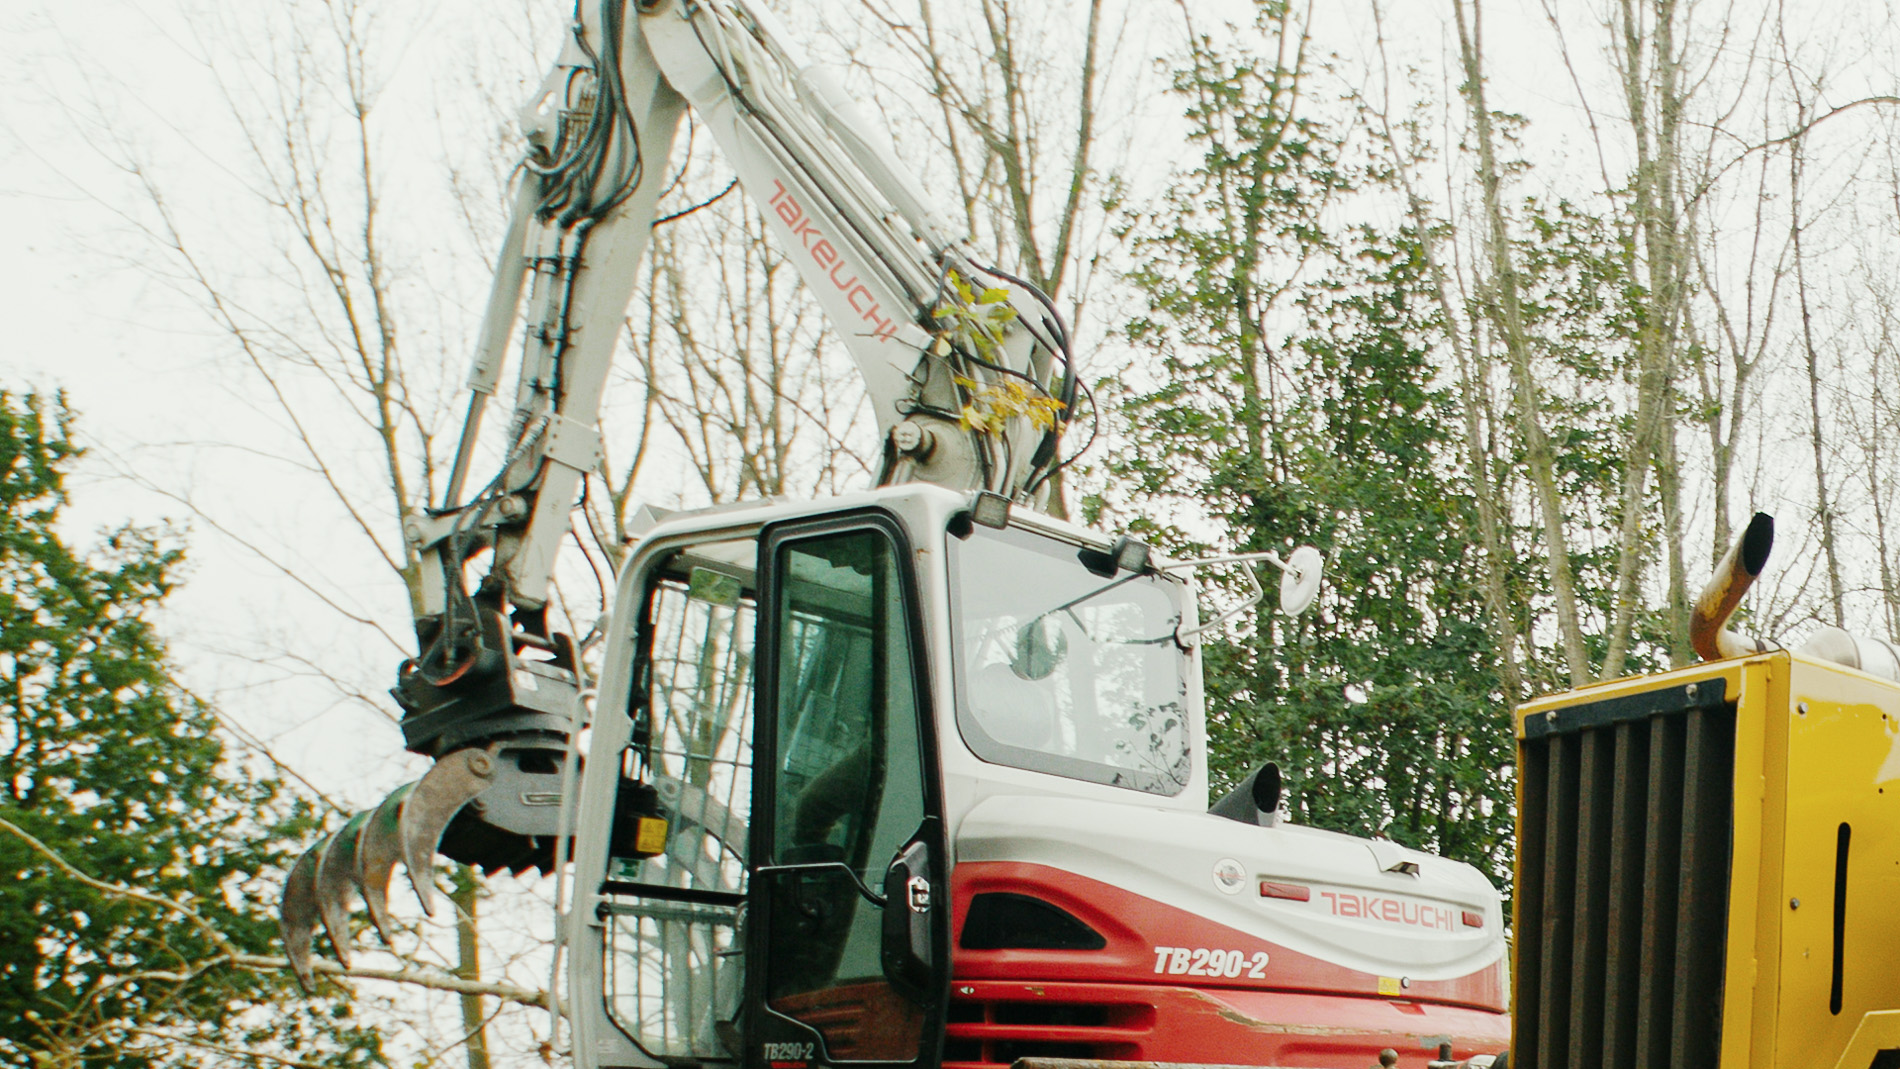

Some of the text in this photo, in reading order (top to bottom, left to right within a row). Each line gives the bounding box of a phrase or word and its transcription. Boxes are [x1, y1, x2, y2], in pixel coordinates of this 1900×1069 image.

[768, 178, 898, 343] TAKEUCHI
[1320, 892, 1455, 932] TAKEUCHI
[1154, 946, 1270, 980] TB290-2
[763, 1042, 815, 1060] TB290-2
